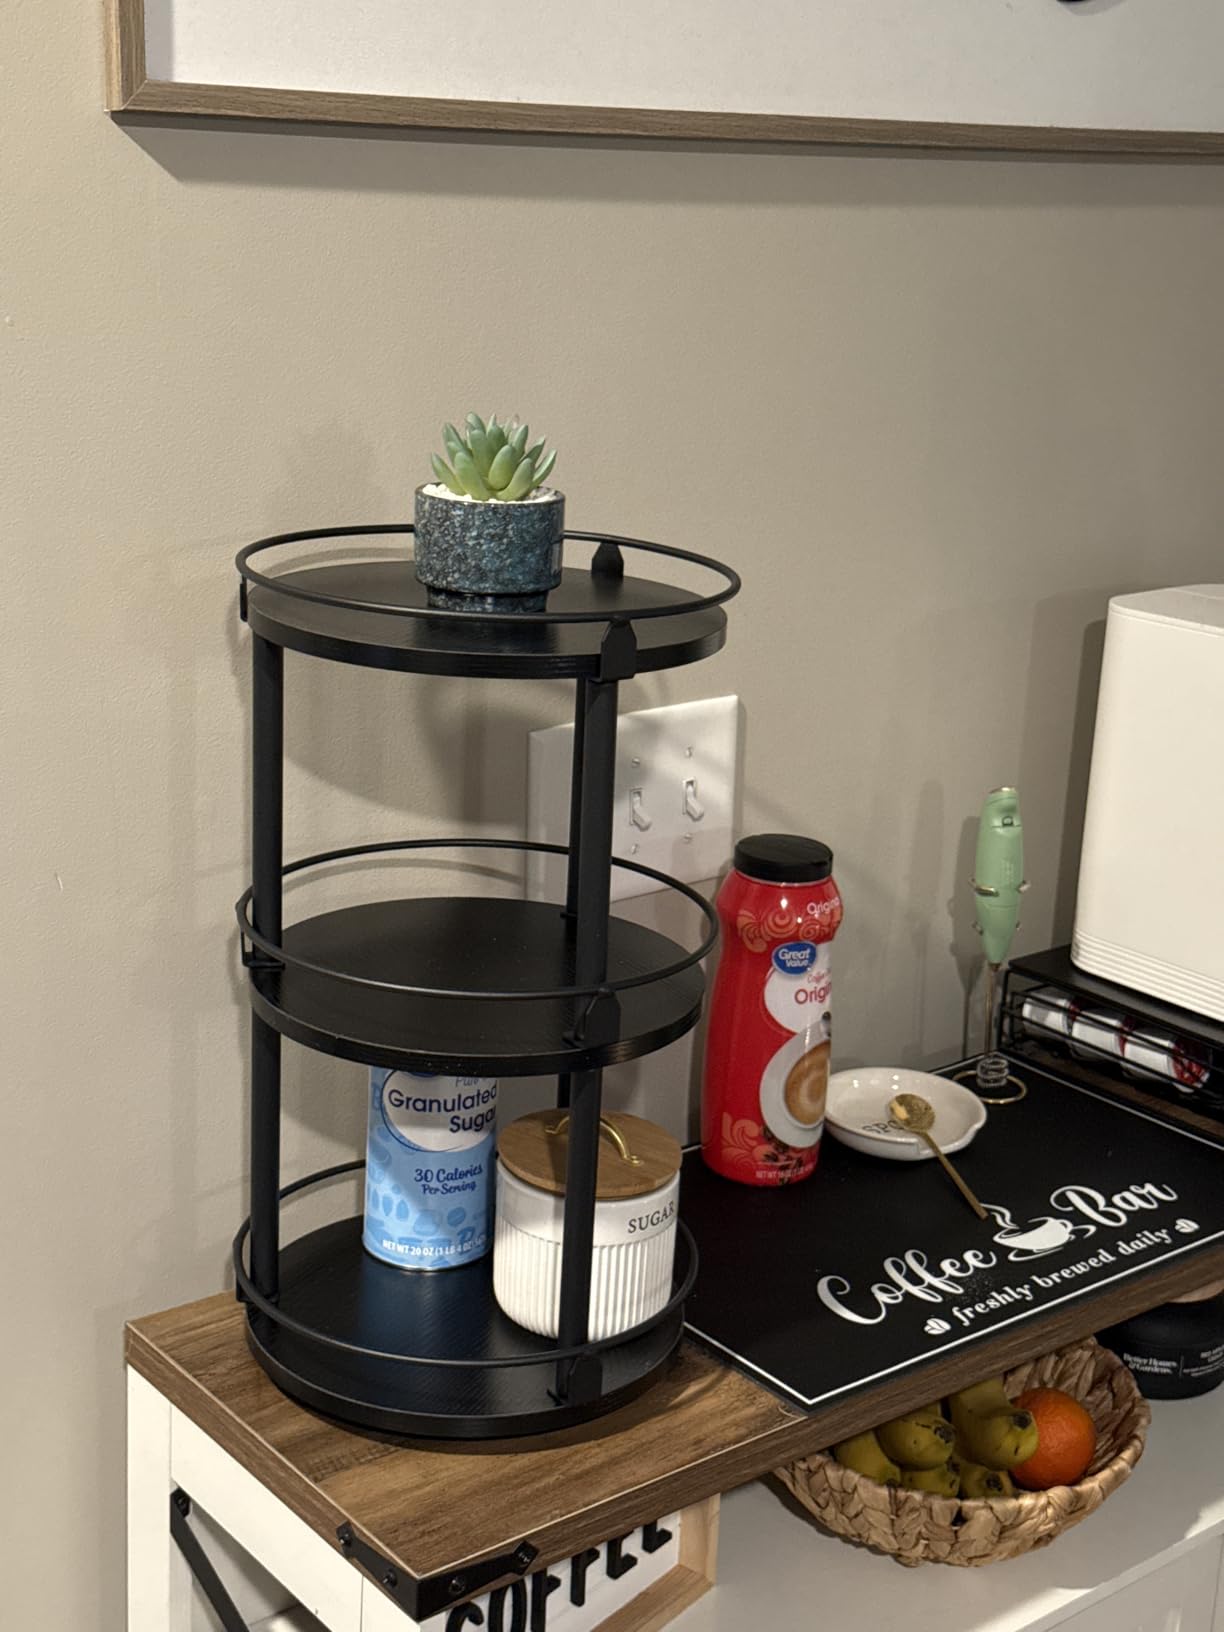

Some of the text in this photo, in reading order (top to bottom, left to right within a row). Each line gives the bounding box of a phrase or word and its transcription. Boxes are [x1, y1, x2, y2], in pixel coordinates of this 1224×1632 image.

[778, 947, 811, 960] Great
[785, 958, 810, 968] Value
[794, 981, 833, 1005] Origin
[388, 1080, 497, 1113] Granulated
[449, 1105, 497, 1133] Suga
[414, 1163, 483, 1183] 30 Calories
[421, 1181, 477, 1195] Per Serving
[627, 1199, 674, 1234] SUGAR
[382, 1239, 396, 1251] NET
[396, 1243, 410, 1255] WT
[410, 1245, 421, 1257] 20
[422, 1246, 435, 1257] OZ
[816, 1181, 1179, 1325] Coffee Bar
[951, 1228, 1171, 1327] freshly brewed daily
